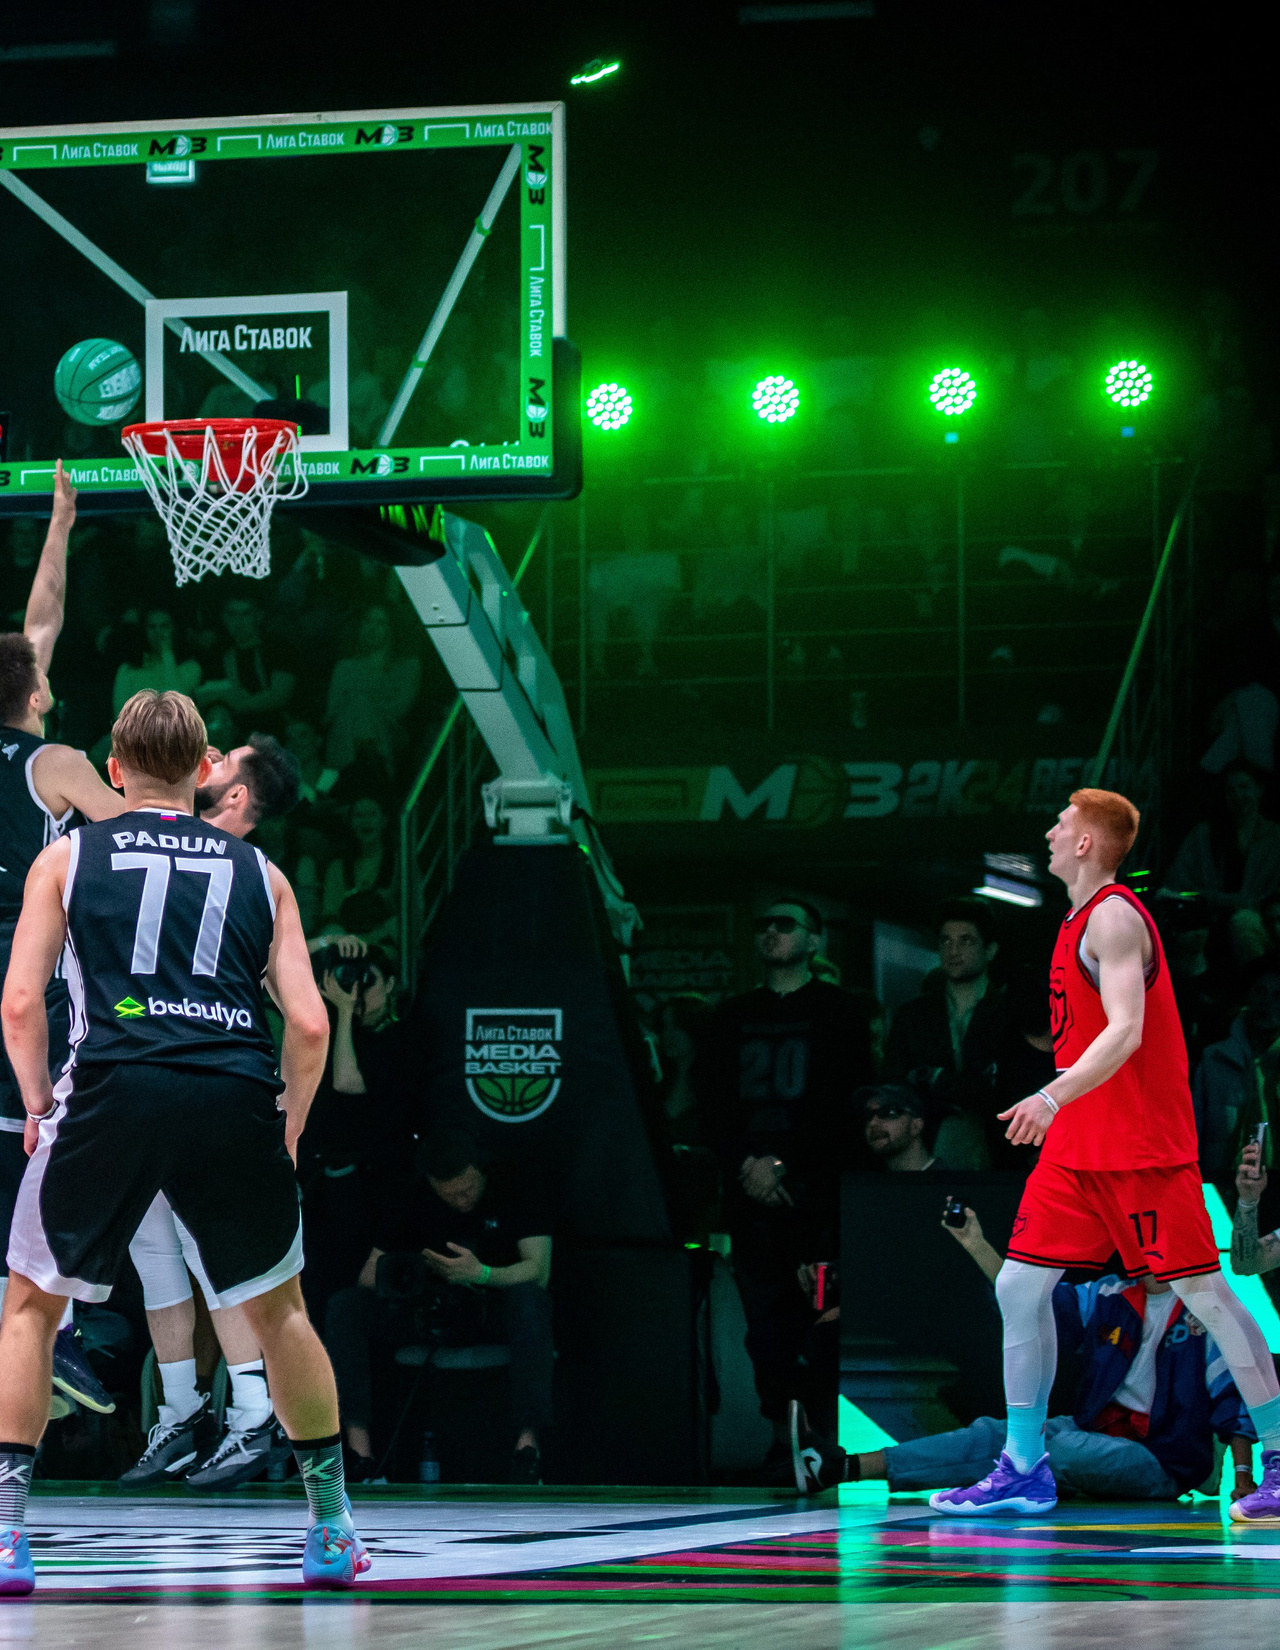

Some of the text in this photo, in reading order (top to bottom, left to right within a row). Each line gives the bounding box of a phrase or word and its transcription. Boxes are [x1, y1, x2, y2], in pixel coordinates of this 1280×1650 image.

[1011, 148, 1161, 216] 207
[101, 466, 147, 482] Ставо
[111, 830, 228, 855] PADUN
[110, 852, 234, 978] 77
[147, 996, 252, 1031] babulya
[465, 1044, 561, 1060] MEDIA
[465, 1062, 562, 1075] BASKET
[1128, 1209, 1157, 1249] 17
